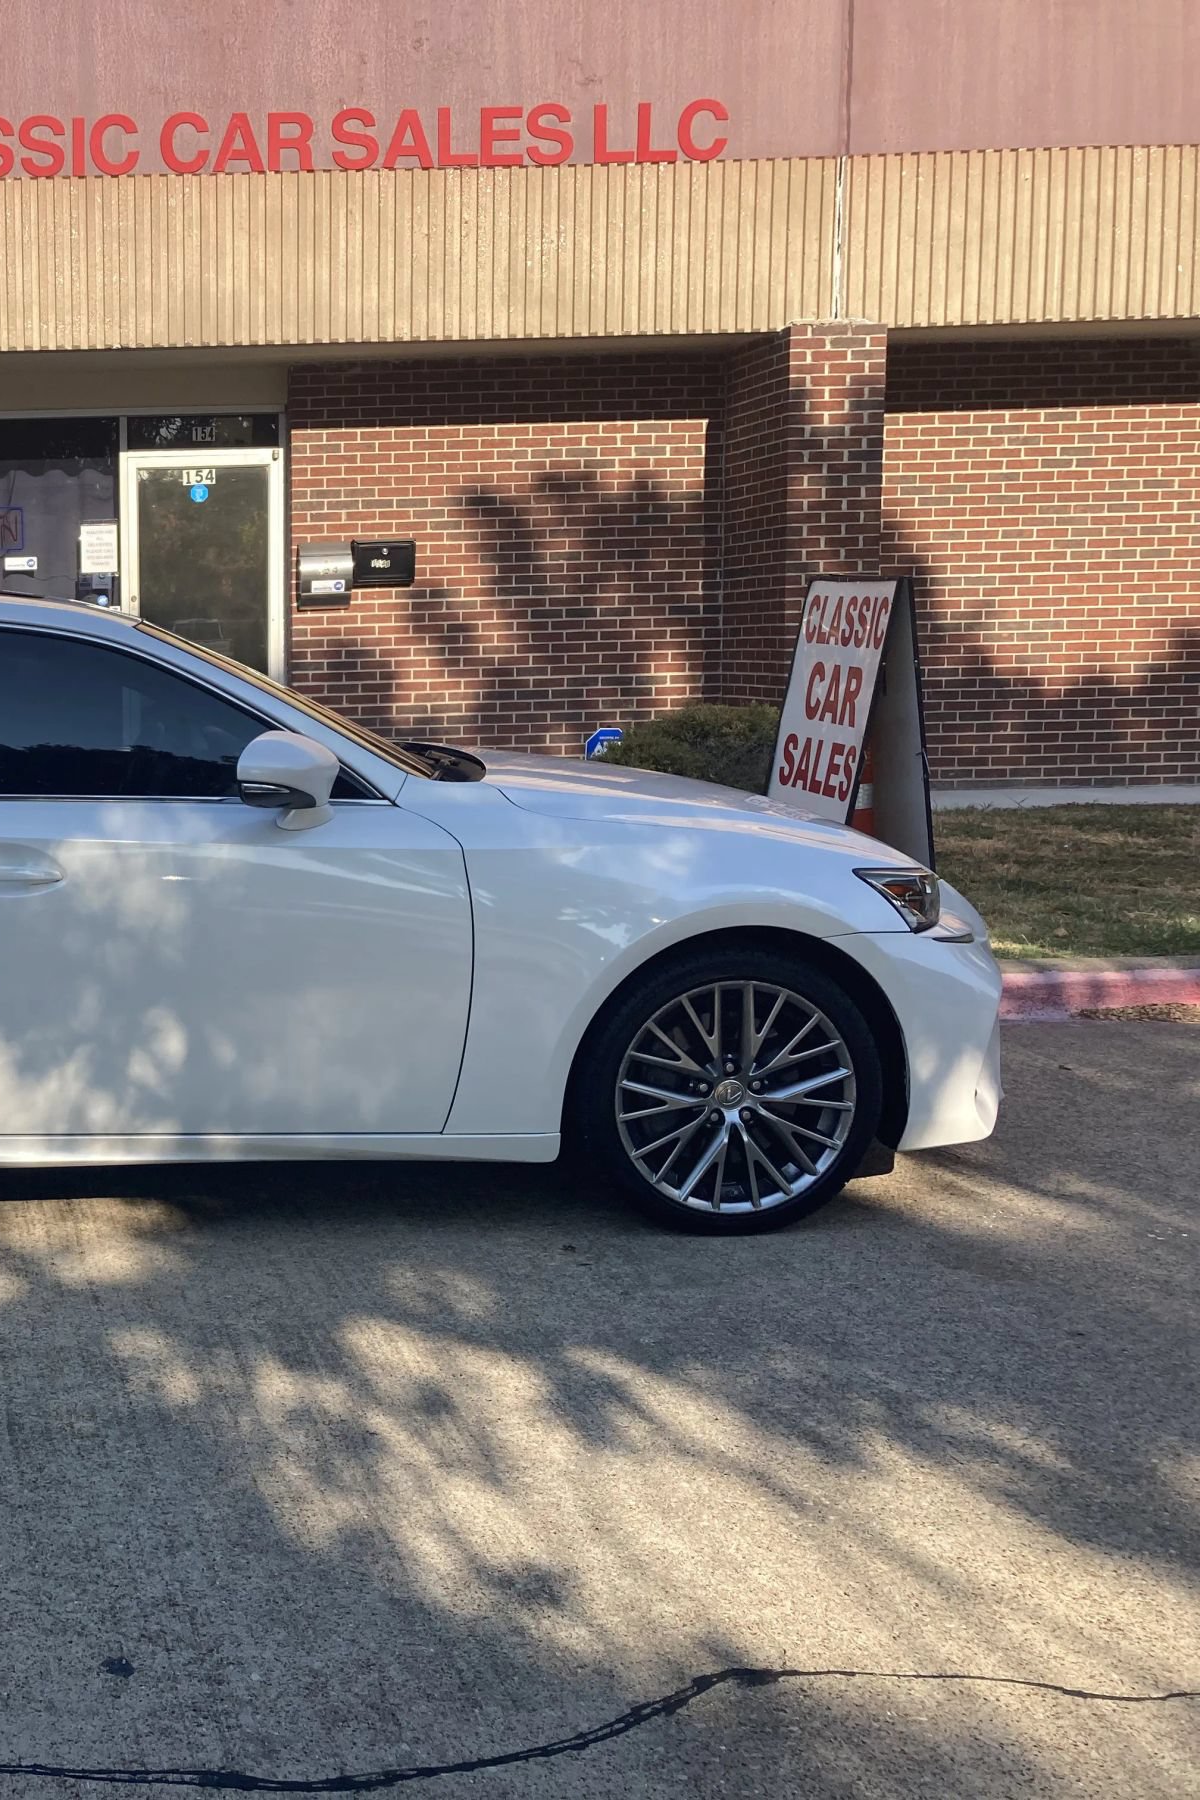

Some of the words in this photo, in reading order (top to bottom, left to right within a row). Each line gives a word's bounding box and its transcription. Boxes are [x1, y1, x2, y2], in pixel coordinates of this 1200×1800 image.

[160, 111, 314, 174] CAR
[331, 103, 574, 170] SALES
[594, 98, 729, 164] LLC
[194, 427, 214, 441] 154
[185, 469, 215, 485] 154
[805, 594, 889, 650] CLASSIC
[805, 661, 863, 728] CAR
[779, 733, 857, 802] SALES
